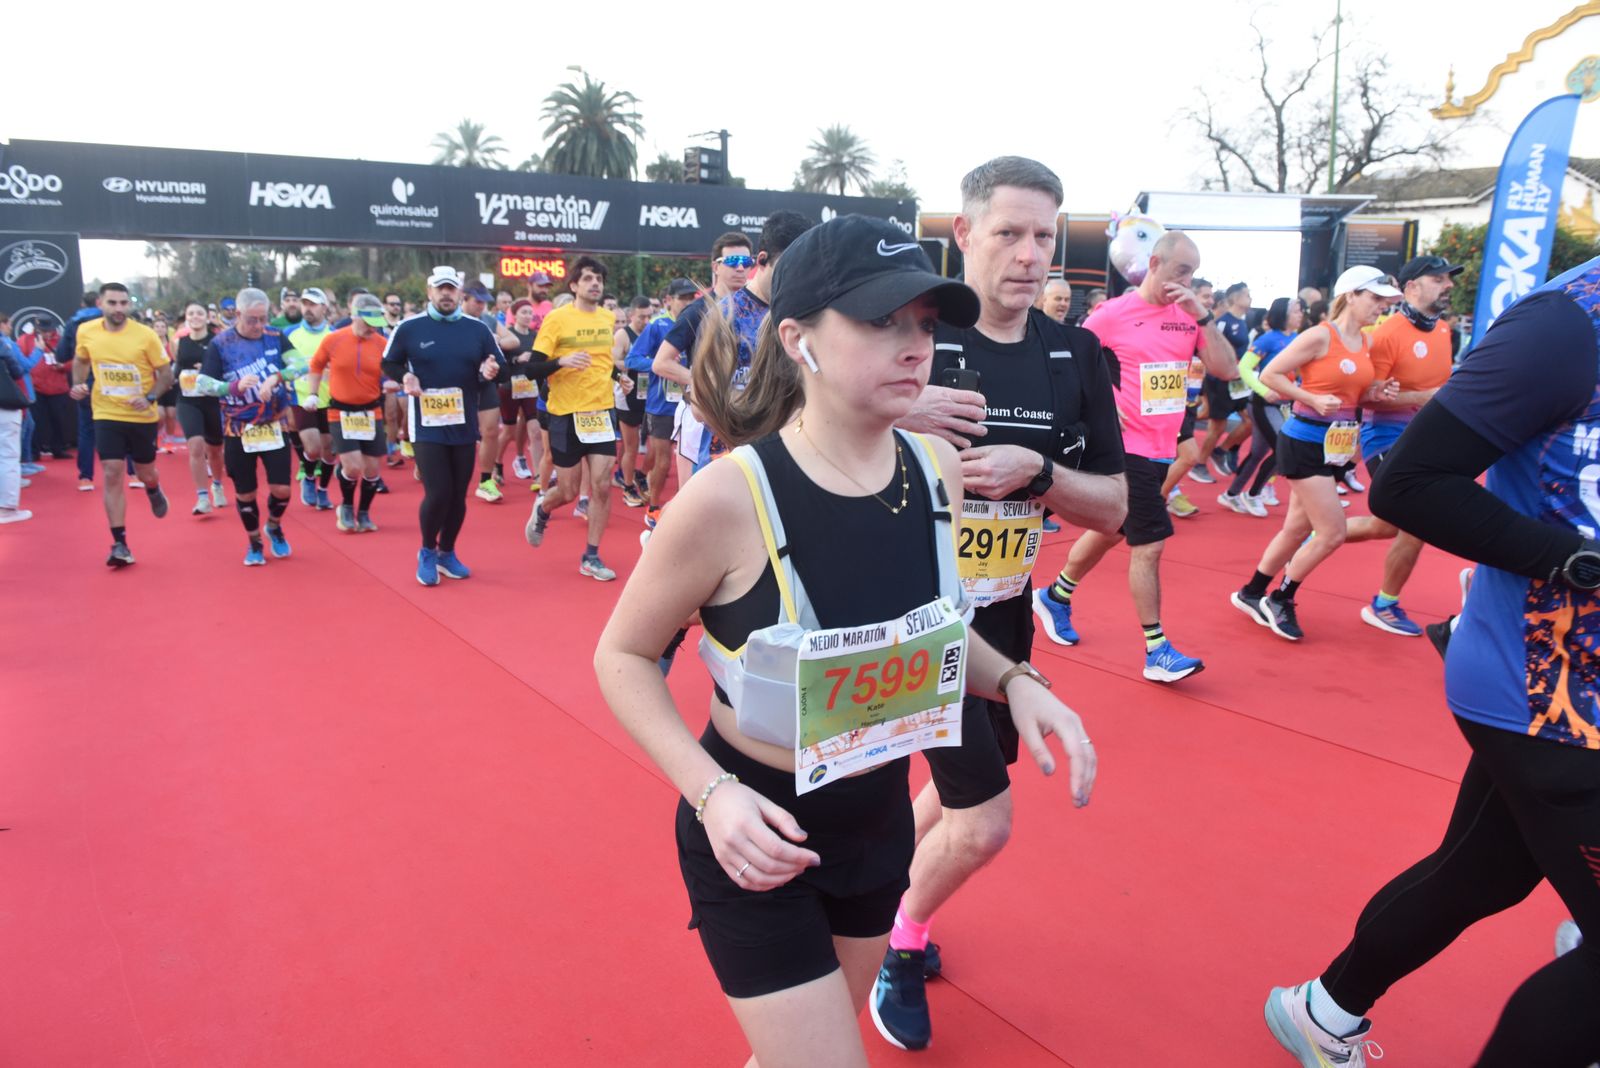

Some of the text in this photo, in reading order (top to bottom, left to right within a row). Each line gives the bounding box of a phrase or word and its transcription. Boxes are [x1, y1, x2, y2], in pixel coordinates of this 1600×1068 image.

[135, 180, 206, 194] HYUNDAI
[1521, 143, 1547, 212] HUMAN
[249, 181, 335, 209] HOKA
[501, 194, 591, 214] maratón
[1507, 181, 1523, 210] FLY
[1535, 183, 1552, 213] FLY
[525, 211, 596, 230] sevilla
[639, 205, 700, 228] HOKA
[514, 231, 578, 243] 28 enero 2024
[501, 258, 565, 278] 00:04:46
[1487, 215, 1547, 331] OKA
[103, 371, 134, 382] 10583
[1150, 374, 1182, 390] 9320
[424, 397, 456, 409] 12841
[580, 416, 603, 428] 9853
[958, 527, 1028, 559] 2917
[810, 633, 839, 652] MEDIO
[842, 624, 886, 648] MARATÓN
[824, 648, 929, 711] 7599
[867, 703, 885, 712] Kate
[864, 745, 888, 758] HOKA
